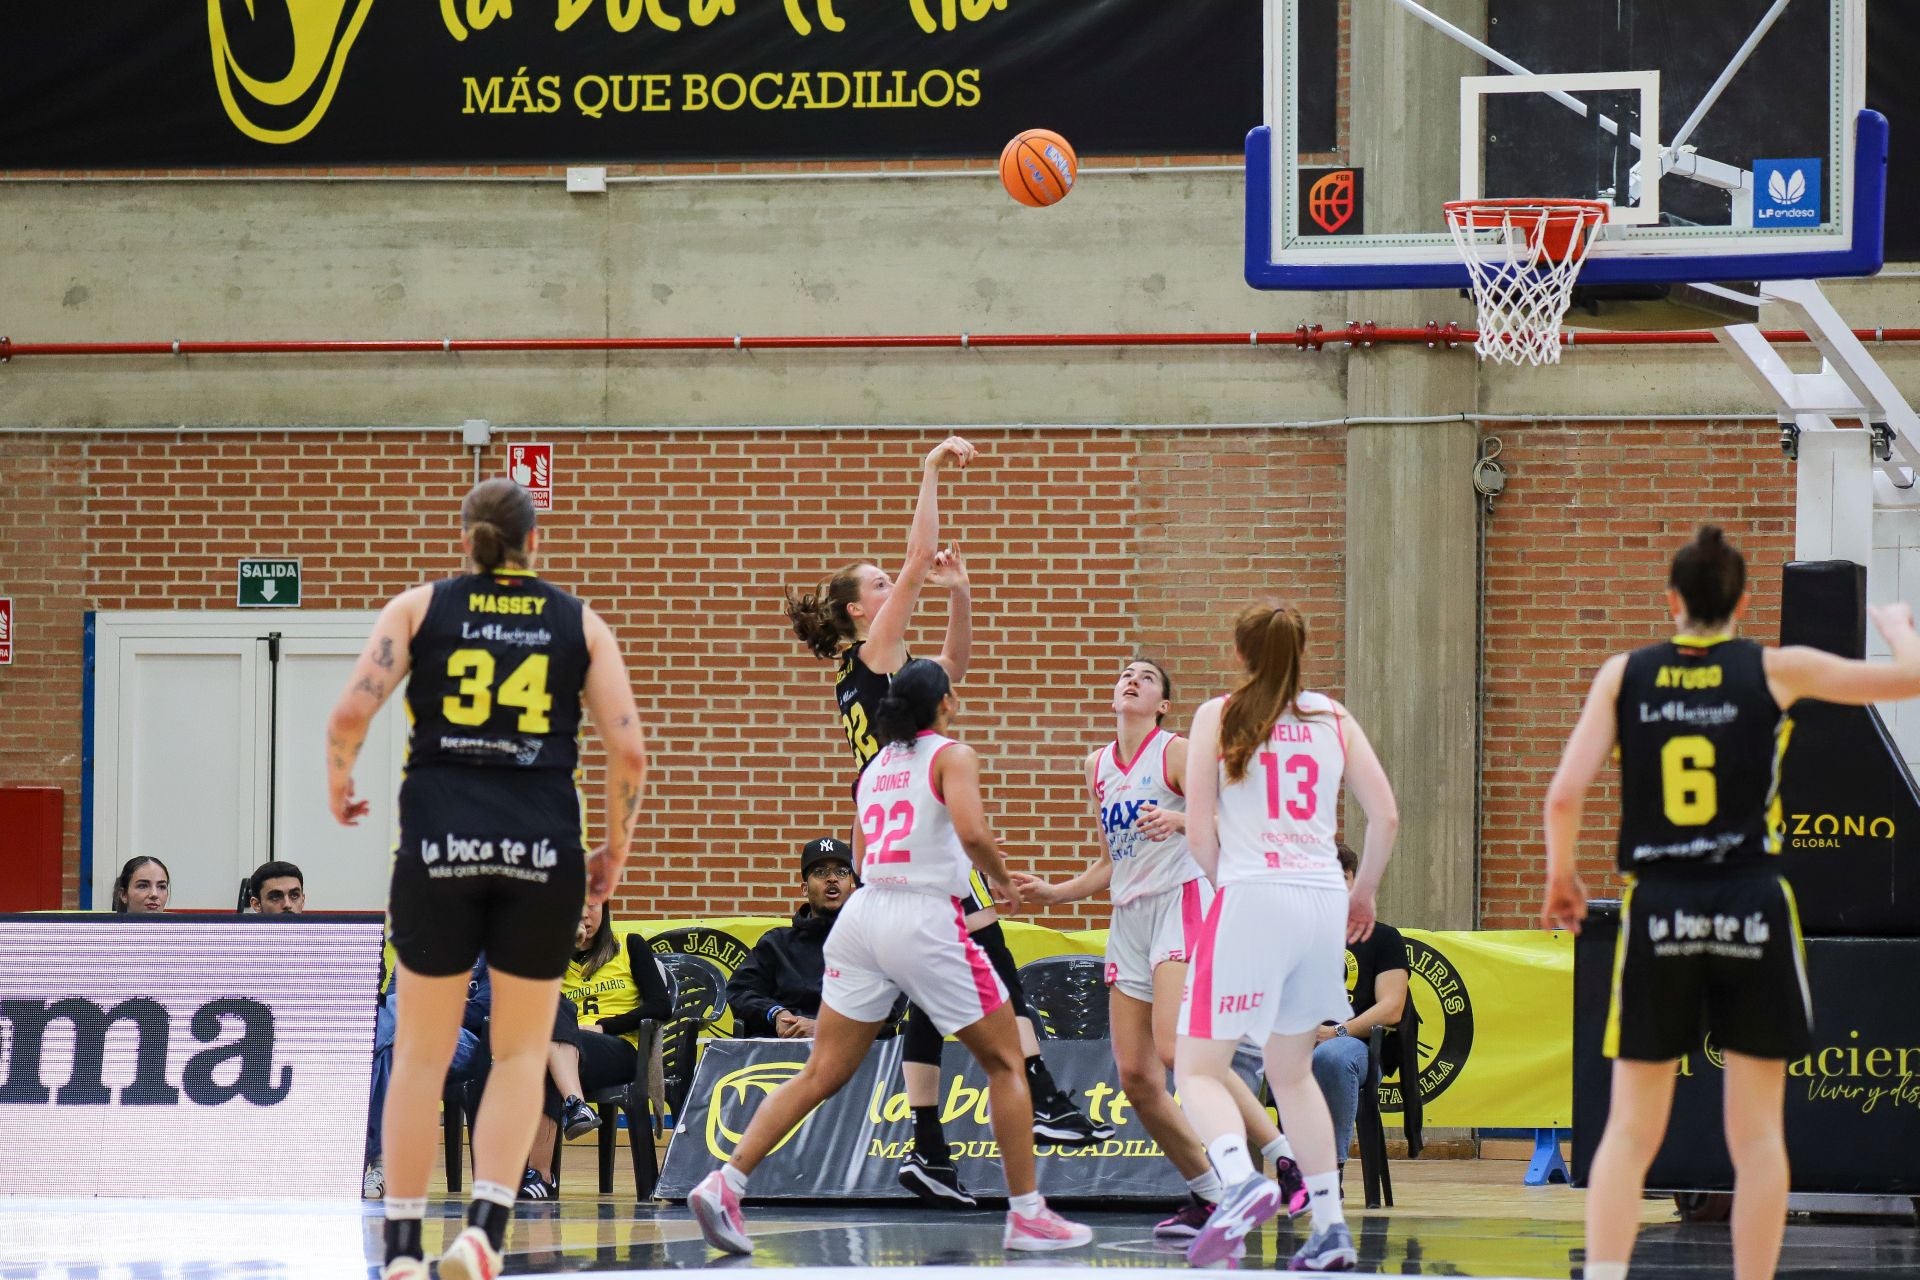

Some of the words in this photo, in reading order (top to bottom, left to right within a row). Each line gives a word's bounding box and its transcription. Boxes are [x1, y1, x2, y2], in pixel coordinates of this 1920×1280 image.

[462, 66, 561, 113] MÁS
[573, 75, 671, 118] QUE
[682, 69, 981, 110] BOCADILLOS
[1758, 208, 1774, 218] LF
[1774, 207, 1815, 218] endesa
[242, 563, 297, 578] SALIDA
[469, 593, 547, 615] MASSEY
[443, 648, 552, 733] 34
[872, 770, 911, 793] JOINER
[1260, 752, 1319, 820] 13
[1661, 734, 1718, 827] 6
[863, 799, 914, 866] 22
[1781, 813, 1896, 839] ZONO
[447, 832, 494, 862] boca
[500, 838, 527, 864] te
[820, 839, 834, 852] NY
[1792, 838, 1841, 848] GLOBAL
[594, 978, 626, 997] JAIRIS
[0, 997, 293, 1107] ma
[1808, 1073, 1864, 1101] Vivir
[1862, 1087, 1888, 1114] y
[868, 1138, 916, 1159] MÁ
[948, 1140, 1003, 1160] QUE
